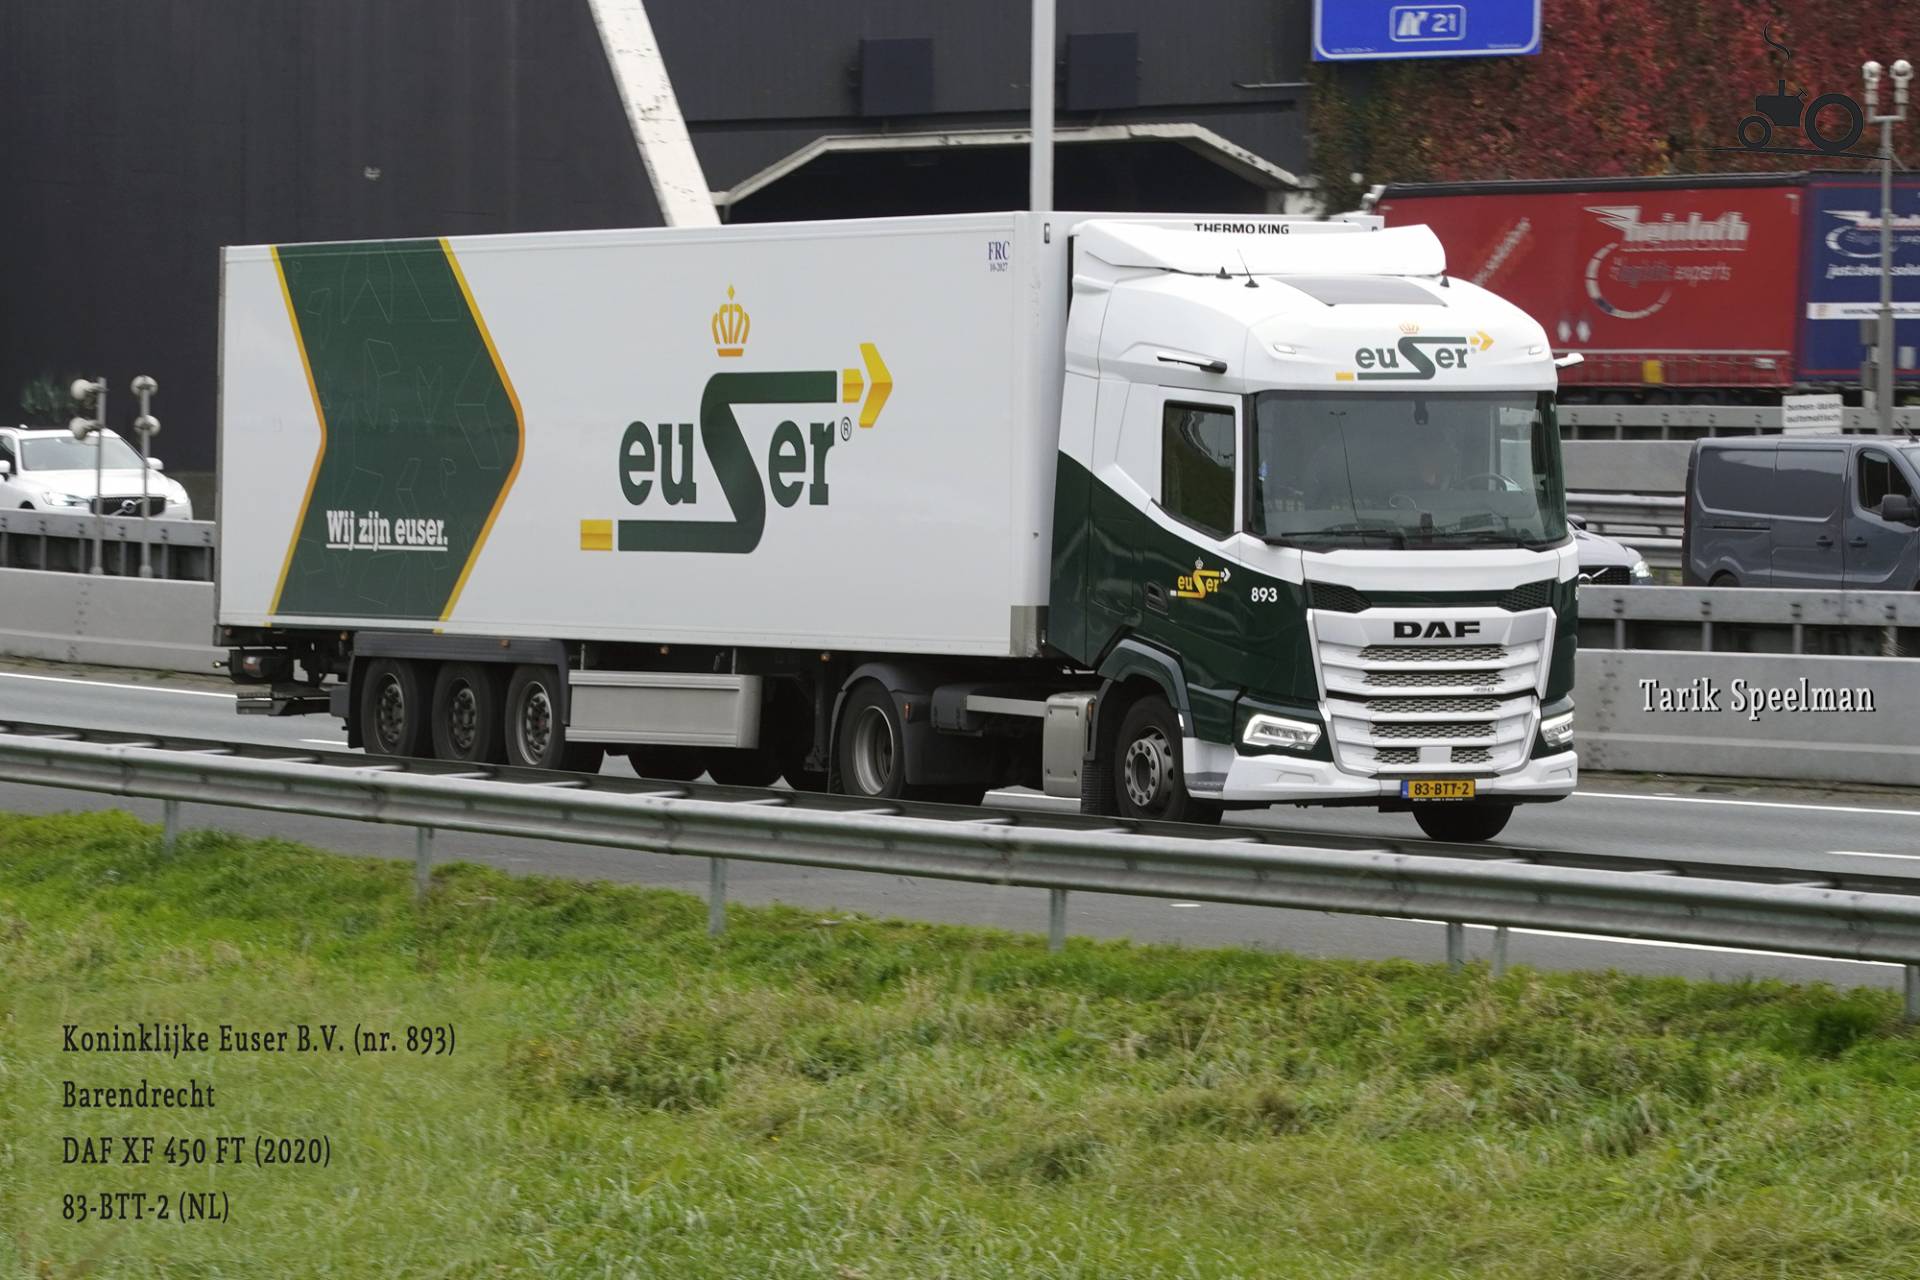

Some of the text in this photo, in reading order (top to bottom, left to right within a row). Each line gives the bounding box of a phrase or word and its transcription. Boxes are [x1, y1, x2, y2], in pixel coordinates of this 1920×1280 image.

[1432, 13, 1456, 33] 21
[1194, 223, 1289, 234] THERMO KING
[988, 240, 1010, 261] FRC
[326, 510, 448, 552] Wij zijn euser.
[1251, 587, 1278, 602] 893
[1393, 621, 1480, 638] DAF
[1414, 783, 1469, 795] 83-BTT-2
